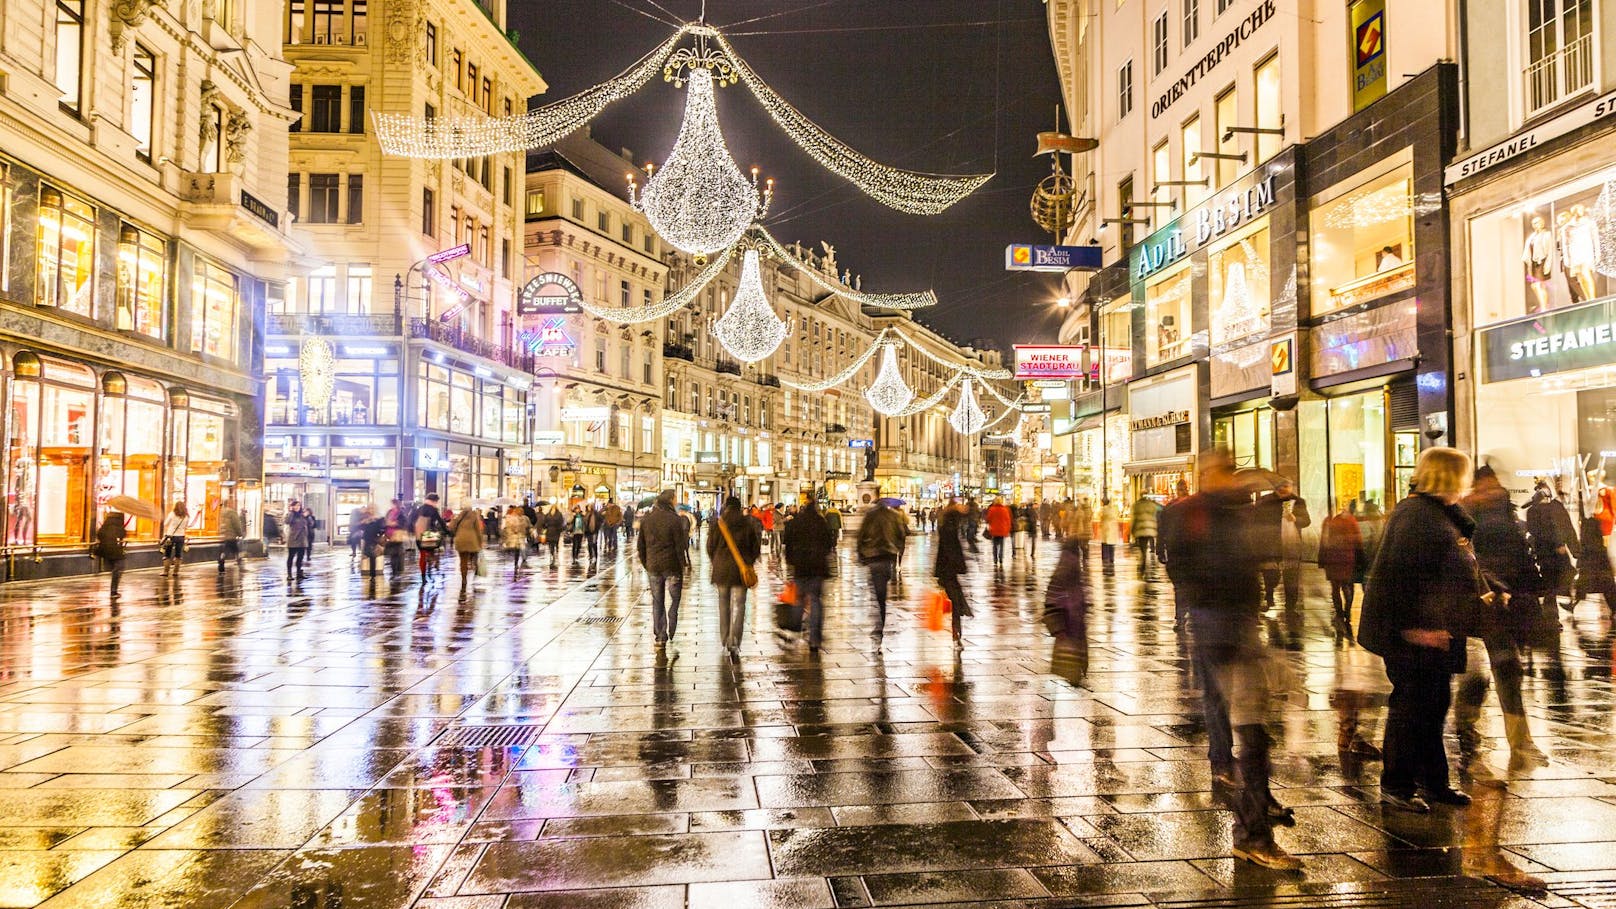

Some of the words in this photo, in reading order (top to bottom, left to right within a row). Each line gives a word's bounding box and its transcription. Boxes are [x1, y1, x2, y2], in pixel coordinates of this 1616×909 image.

[1152, 0, 1276, 119] ORIENTTEPPICHE
[1461, 134, 1538, 177] STEFANEL
[1195, 174, 1277, 248] BESIM
[1035, 249, 1071, 265] BESIM
[533, 296, 569, 306] BUFFET
[1030, 354, 1069, 362] WIENER
